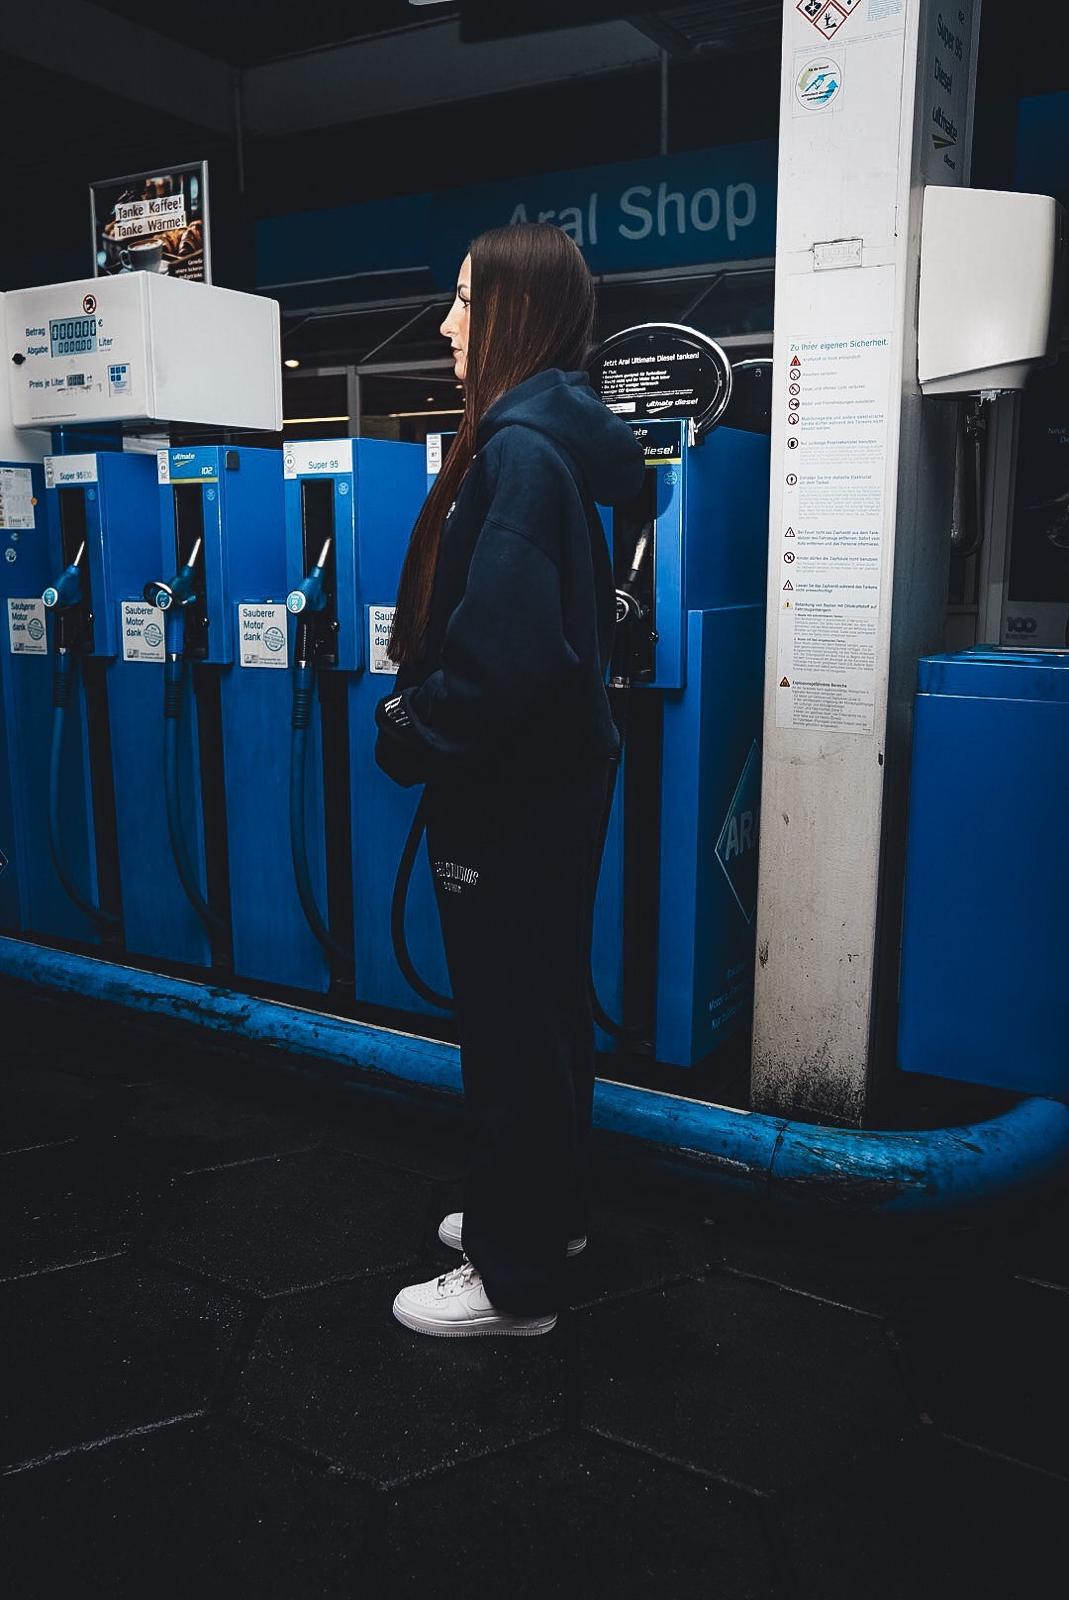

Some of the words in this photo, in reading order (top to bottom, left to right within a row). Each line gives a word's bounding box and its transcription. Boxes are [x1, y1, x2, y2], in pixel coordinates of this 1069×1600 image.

[118, 204, 143, 219] Tanke
[149, 197, 182, 213] Kaffee!
[618, 182, 757, 242] Shop
[117, 223, 143, 237] Tanke
[147, 214, 184, 231] Wärme!
[25, 328, 46, 337] Betrag
[99, 337, 113, 347] Liter
[850, 339, 888, 348] Sicherheit.
[27, 346, 48, 355] Abgabe
[657, 354, 675, 362] Diesel
[29, 380, 43, 388] Preis
[44, 379, 50, 388] je
[51, 378, 64, 386] Liter
[308, 461, 328, 470] Super
[330, 460, 339, 468] 95
[201, 466, 213, 475] 102
[60, 472, 75, 480] Super
[125, 605, 153, 614] Sauberer
[242, 608, 275, 617] Sauberer
[126, 617, 144, 625] Motor
[243, 621, 264, 629] Motor
[127, 628, 141, 636] dank
[244, 632, 261, 641] dank
[375, 636, 389, 646] dan
